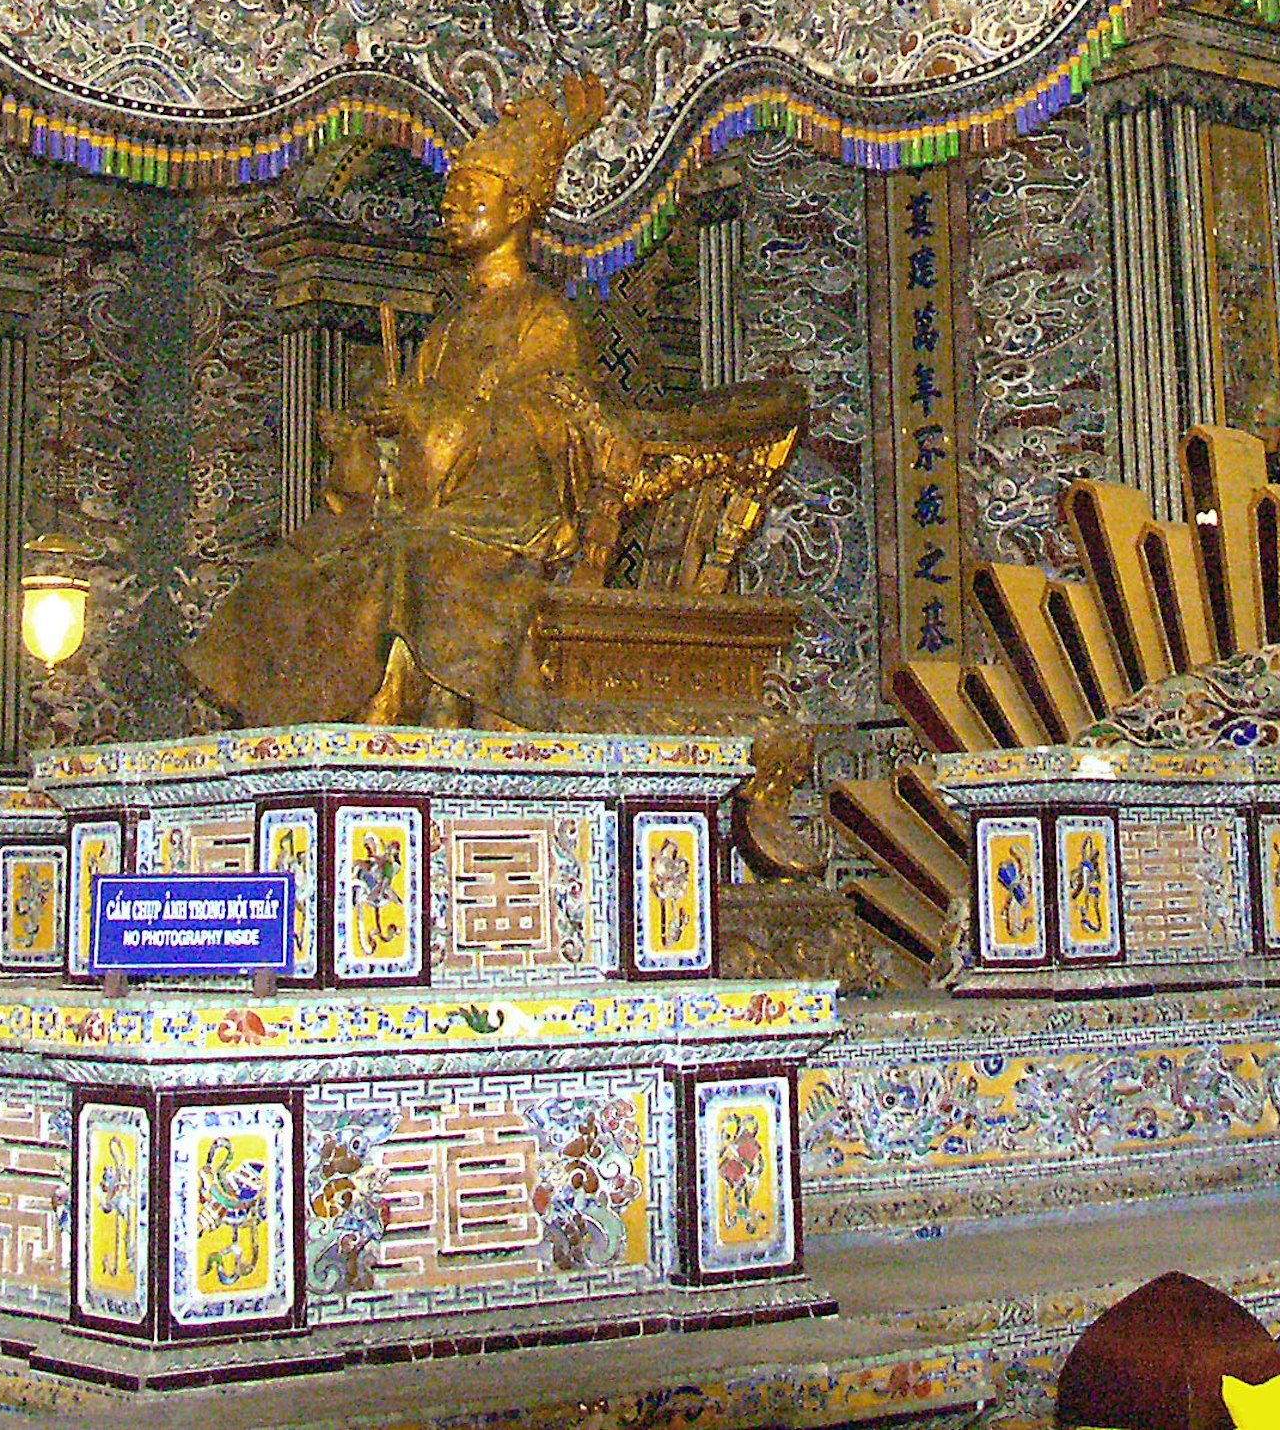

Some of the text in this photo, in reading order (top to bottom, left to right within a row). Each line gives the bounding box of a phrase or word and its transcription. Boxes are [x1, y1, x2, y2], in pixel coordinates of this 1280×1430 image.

[105, 888, 280, 926] CẤM CHỤP ẢNH TRONG NỘI THẤT
[122, 928, 261, 947] NO PHOTOGRAPHY INSIDE
